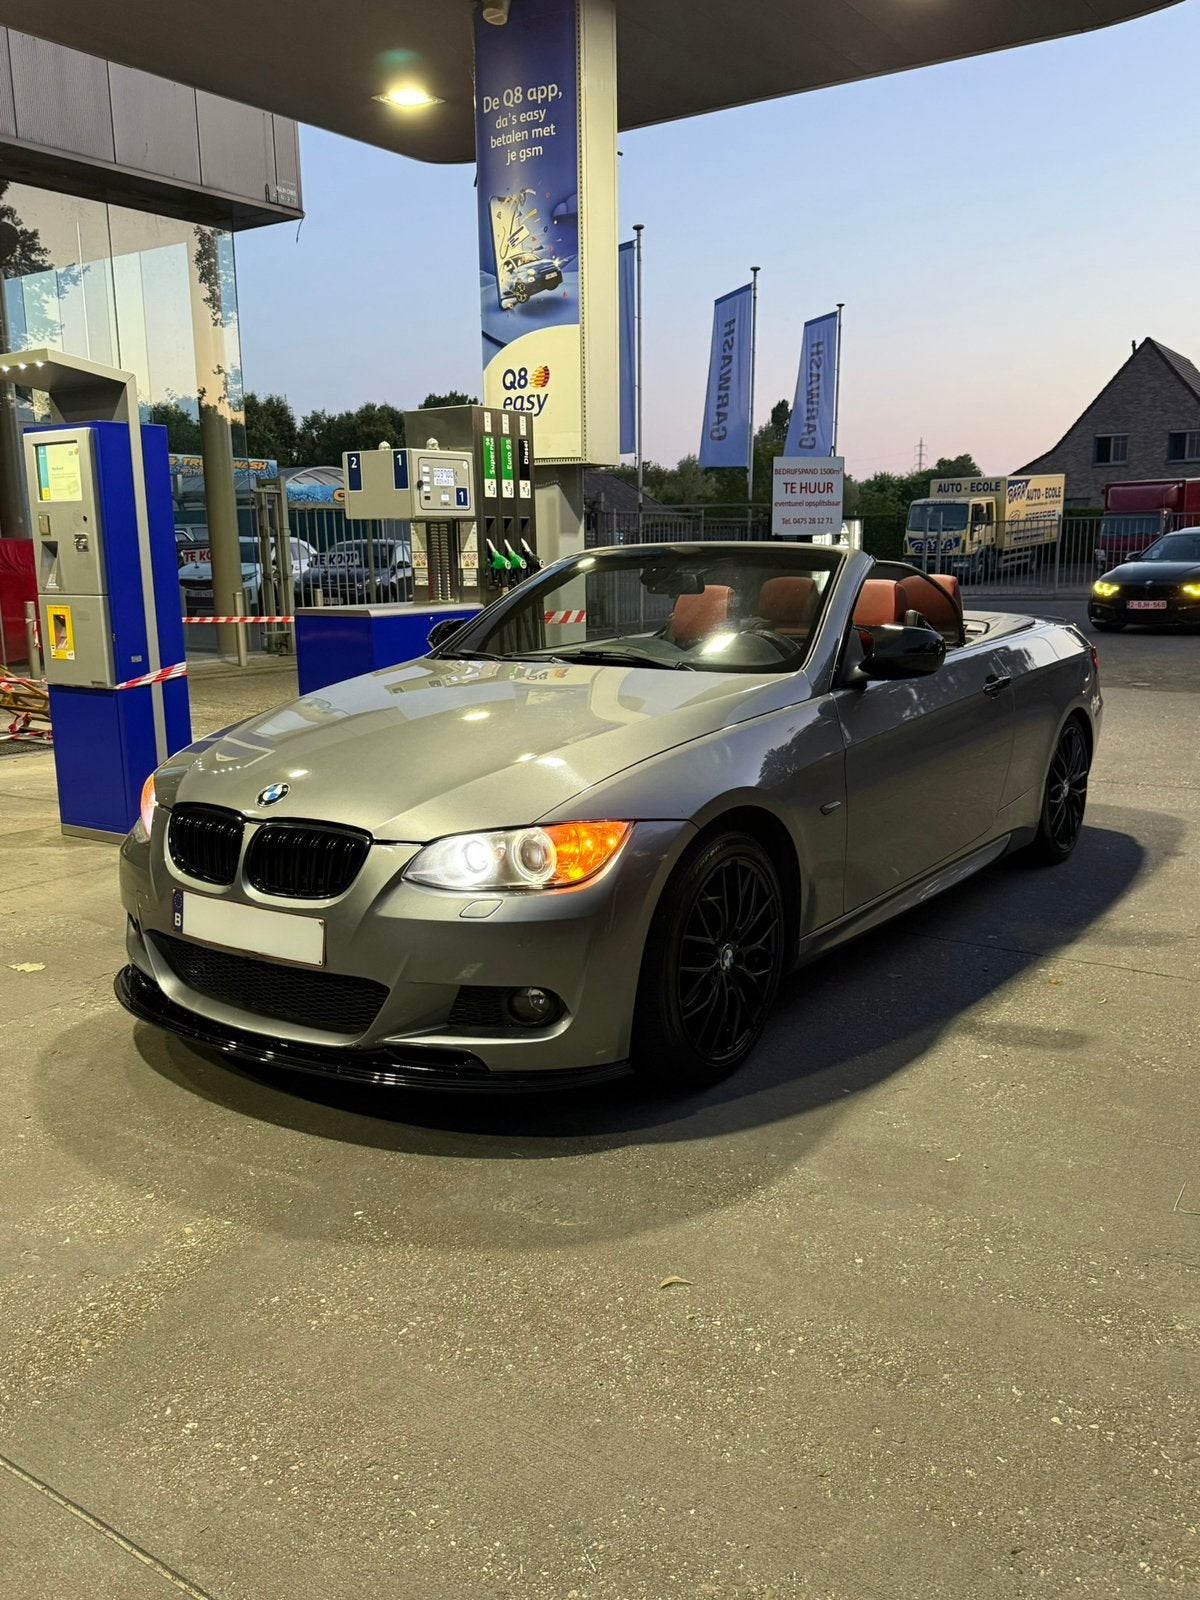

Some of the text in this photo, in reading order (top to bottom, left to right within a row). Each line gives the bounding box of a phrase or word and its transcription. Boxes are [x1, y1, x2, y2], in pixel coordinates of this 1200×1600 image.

[483, 83, 563, 113] De Q8 app,
[495, 108, 547, 129] da's easy
[490, 123, 556, 149] betalen met
[506, 145, 543, 166] je gsm
[502, 366, 528, 391] Q8
[503, 393, 549, 417] easy
[351, 456, 358, 469] 2
[396, 454, 402, 466] 1
[774, 467, 819, 475] BEDRIJFSPAND
[783, 482, 834, 494] TE HUUR
[937, 483, 962, 493] AUTO
[970, 481, 1001, 492] ECOLE
[1026, 487, 1041, 501] AUTO
[1045, 486, 1061, 499] ECOLE
[459, 491, 464, 503] 1
[774, 499, 804, 507] eventueel
[184, 551, 196, 562] TE
[174, 912, 182, 927] B
